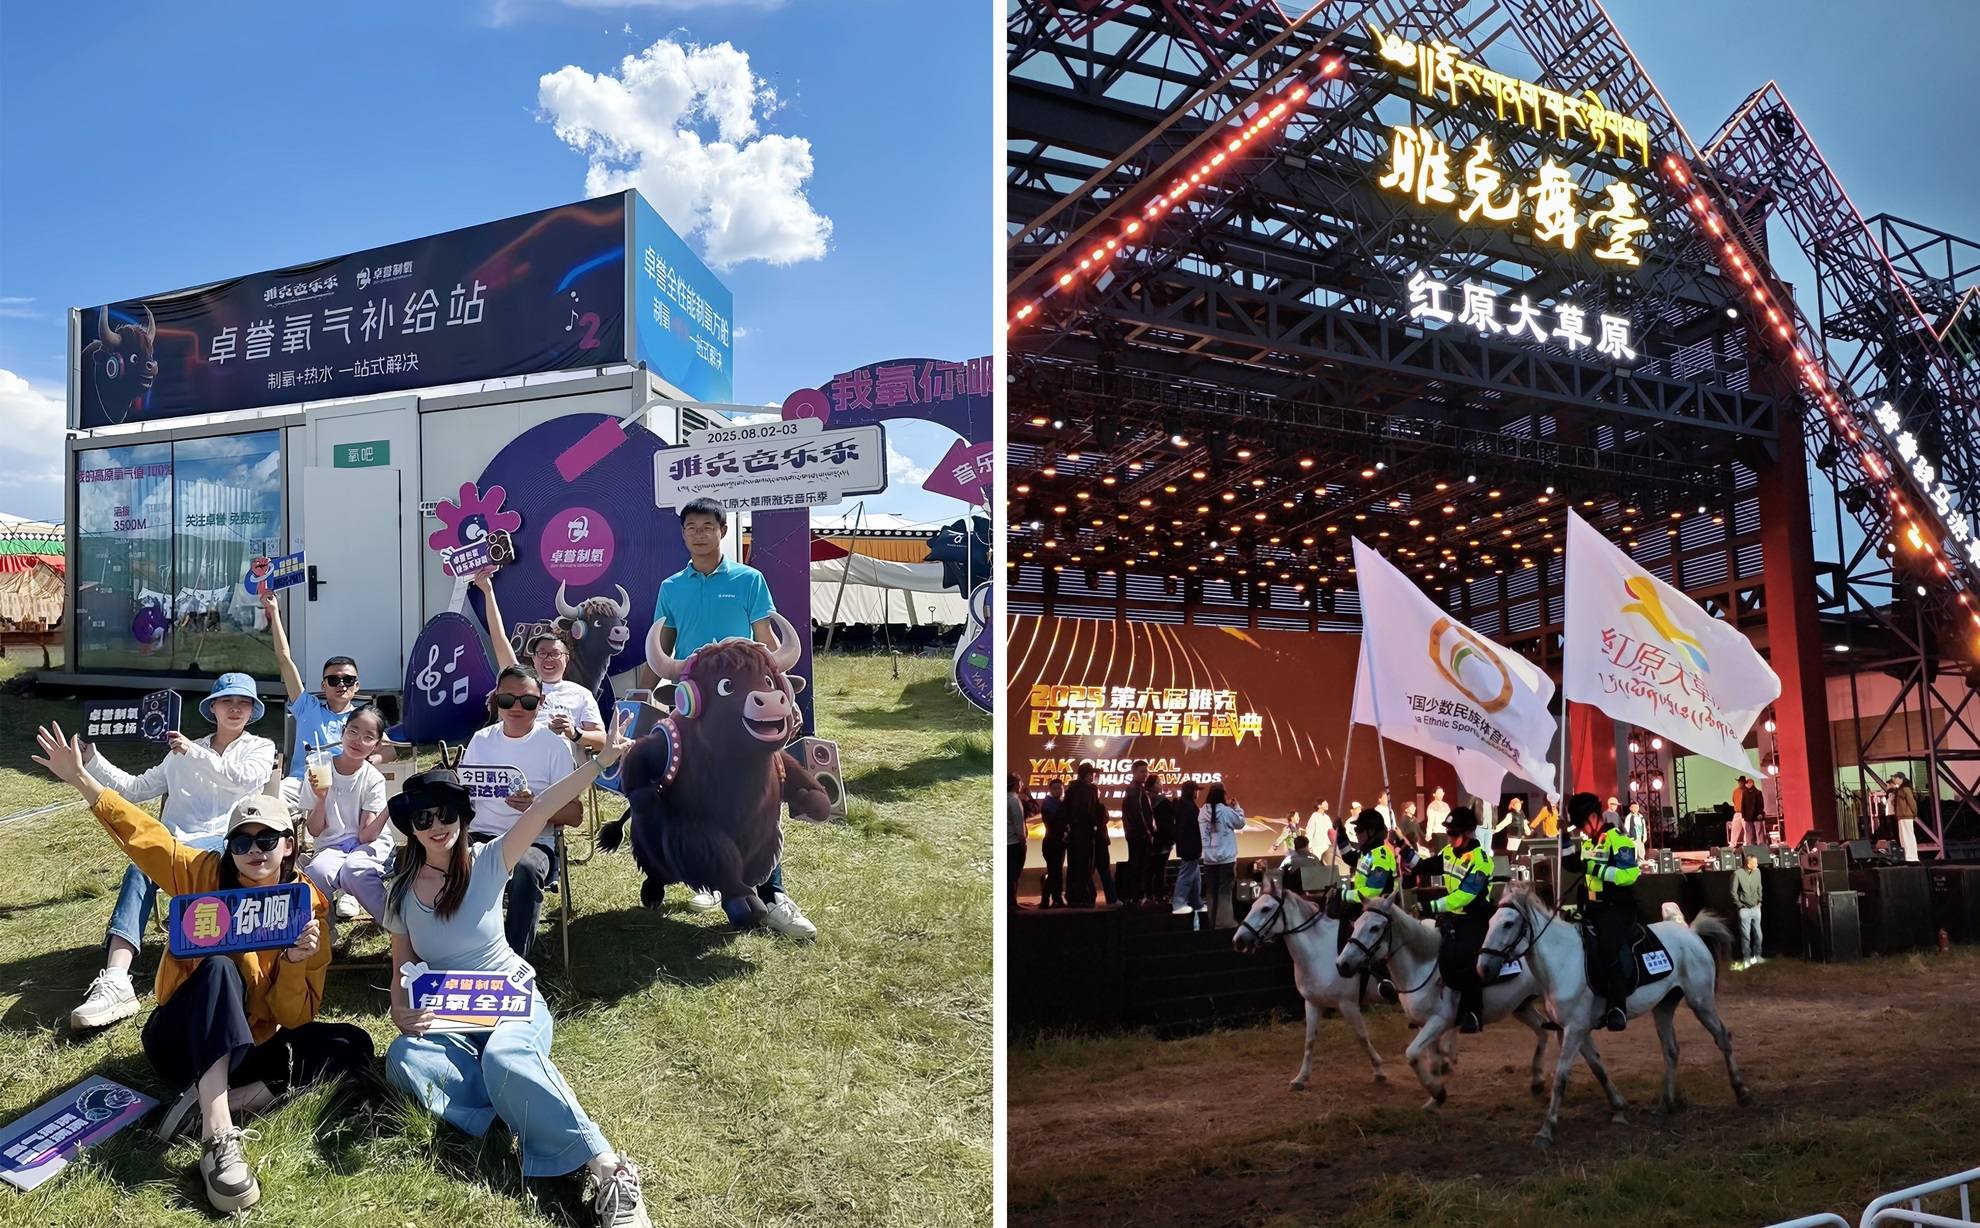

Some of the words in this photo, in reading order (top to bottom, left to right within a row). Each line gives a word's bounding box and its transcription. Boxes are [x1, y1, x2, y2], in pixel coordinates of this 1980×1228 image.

[208, 279, 488, 365] 卓誉氧气补给站
[1407, 270, 1636, 360] 红原大草原
[267, 364, 333, 391] 制氧+热水
[338, 352, 420, 379] 一站式解决
[707, 423, 799, 444] 2025.08.02-03
[113, 518, 147, 531] 3500M
[551, 548, 604, 563] 卓誉制氧
[1030, 684, 1107, 708] 2025
[1110, 686, 1239, 711] 第六届雅克
[1028, 709, 1264, 747] 民族原创音乐盛典
[1424, 716, 1450, 729] Ethnic
[1029, 758, 1076, 774] YAK
[462, 770, 509, 784] 今日氧分
[511, 963, 530, 983] call
[444, 979, 504, 991] 卓誉制氧
[419, 993, 528, 1012] 包氧全场
